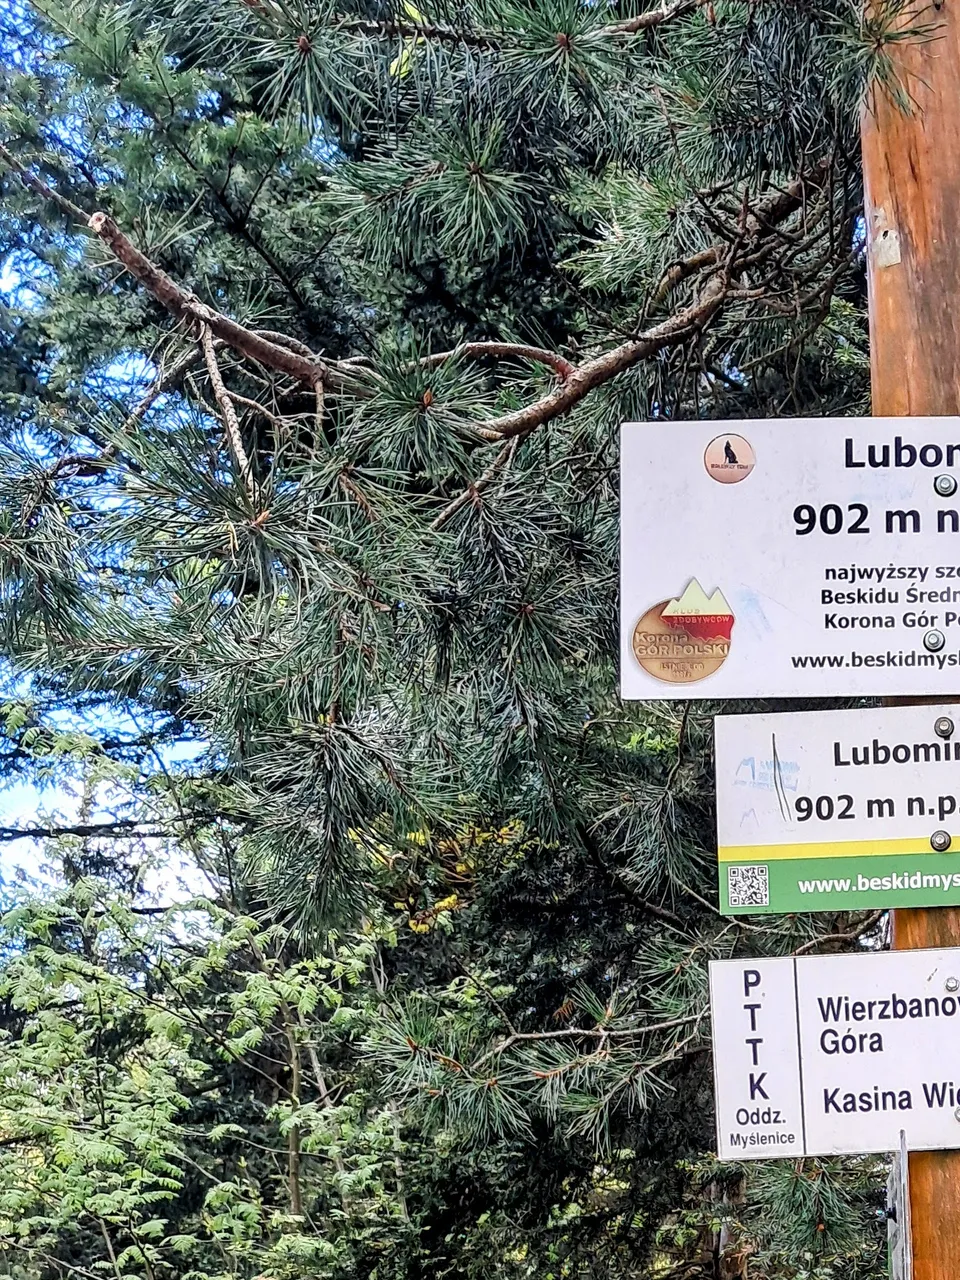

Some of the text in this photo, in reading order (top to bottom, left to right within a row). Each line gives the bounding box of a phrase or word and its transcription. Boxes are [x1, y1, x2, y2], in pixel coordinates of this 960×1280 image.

[794, 503, 870, 535] 902
[886, 510, 920, 533] m
[826, 562, 929, 583] najwyższy
[822, 588, 899, 605] Beskidu
[825, 613, 895, 629] Korona
[903, 610, 939, 628] Gór
[635, 631, 689, 643] Korona
[673, 644, 728, 656] POLSKI
[795, 795, 856, 821] 902
[867, 799, 895, 819] m
[820, 1028, 884, 1055] Góra
[823, 1086, 913, 1114] Kasina
[736, 1106, 786, 1126] Oddz.
[730, 1131, 795, 1149] Myślenice
